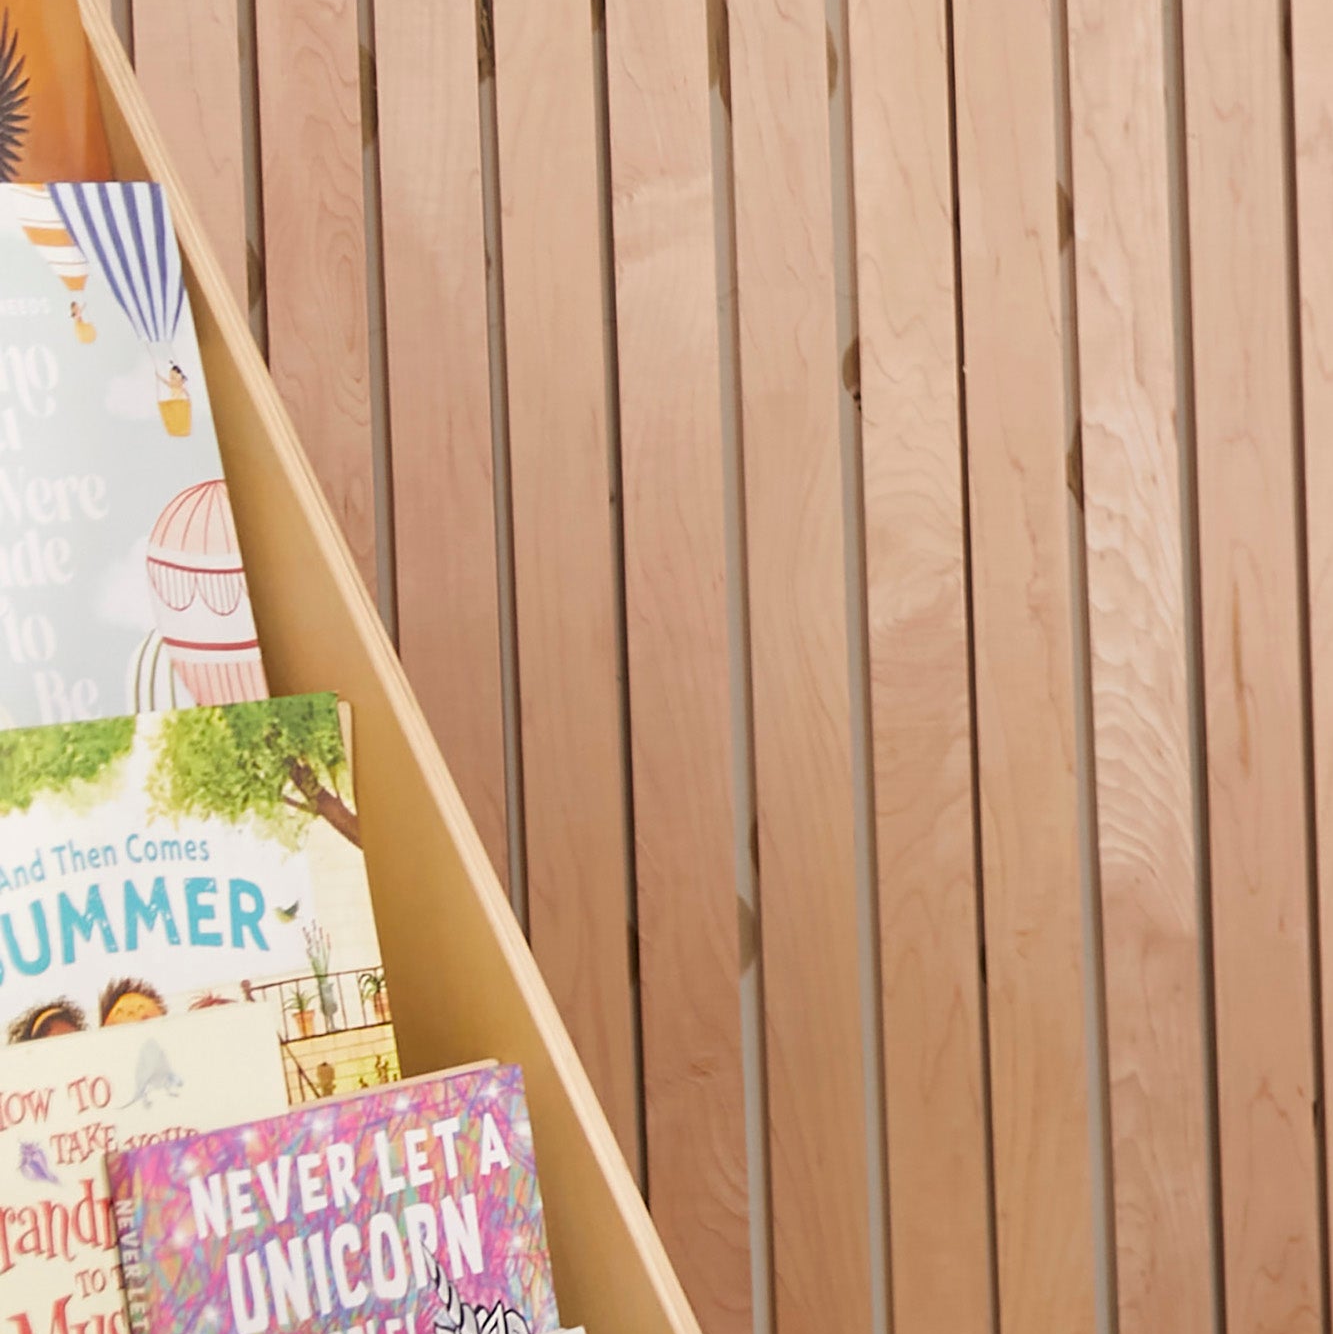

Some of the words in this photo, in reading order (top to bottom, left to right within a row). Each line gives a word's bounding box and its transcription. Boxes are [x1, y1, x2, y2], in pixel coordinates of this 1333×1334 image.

[51, 839, 119, 875] Then
[125, 833, 210, 864] Comes
[0, 876, 270, 988] UMMER
[67, 1075, 112, 1114] TO
[50, 1120, 120, 1166] TAKE
[189, 1143, 361, 1241] NEVER
[372, 1114, 462, 1196] LET
[480, 1113, 512, 1177] A
[75, 1268, 107, 1299] TO
[115, 1199, 139, 1279] NEVER
[127, 1285, 150, 1331] LET
